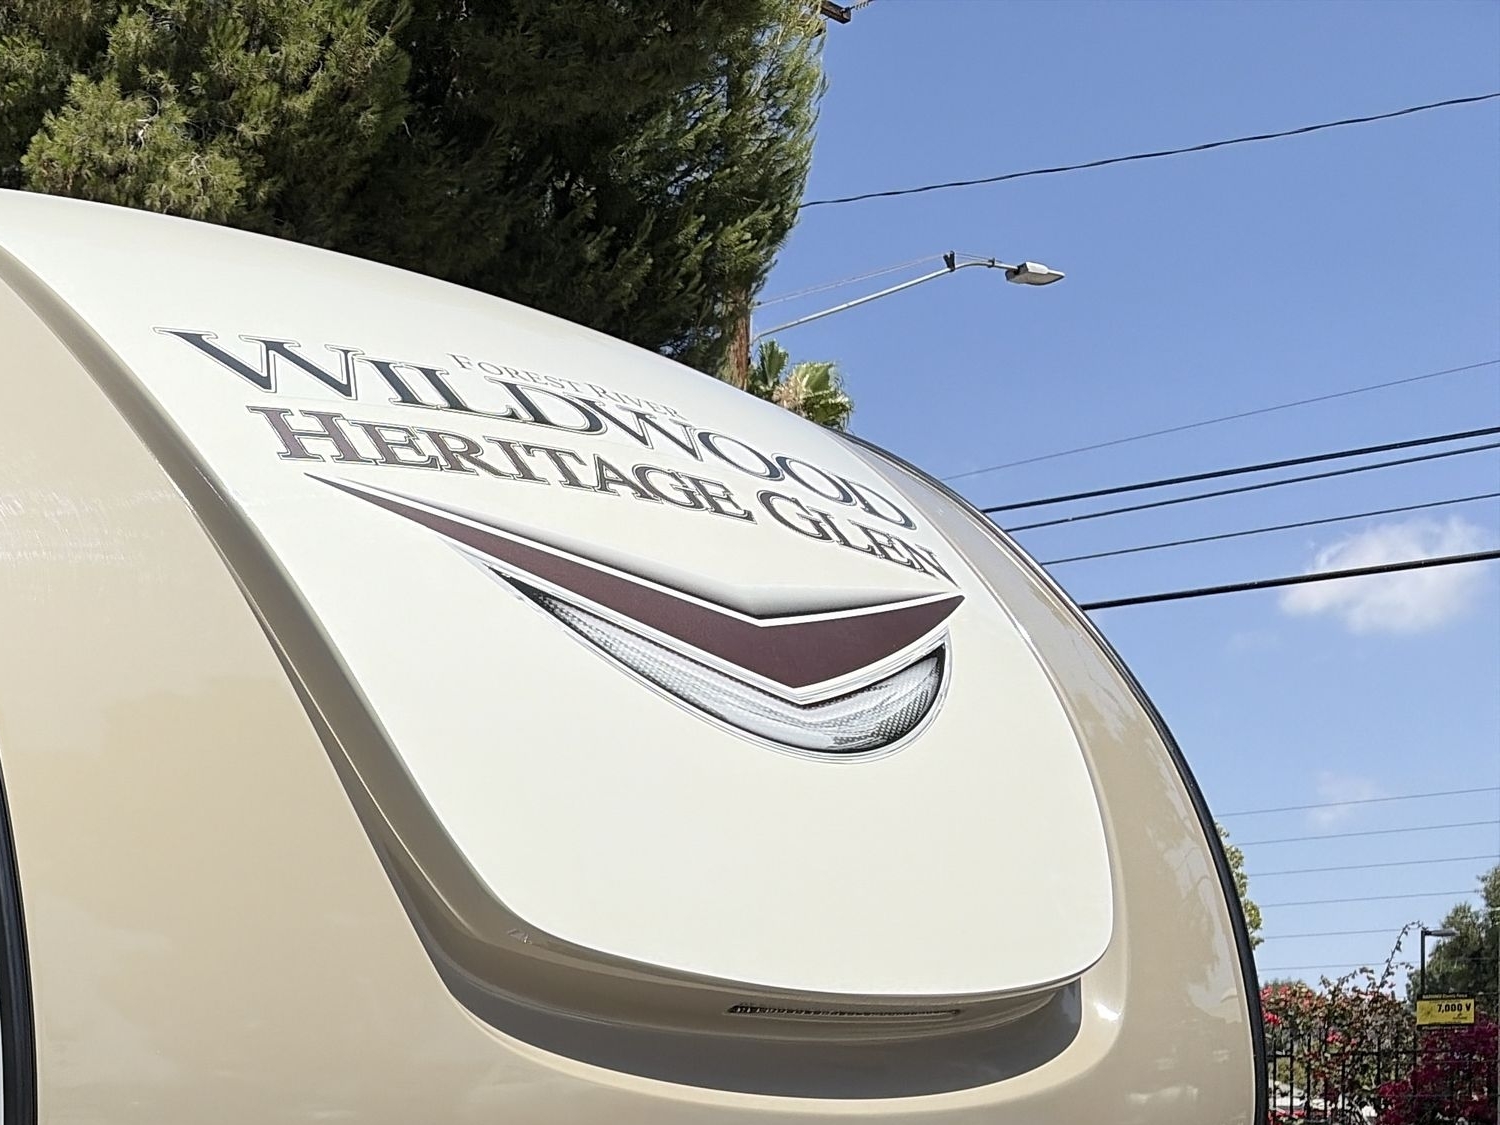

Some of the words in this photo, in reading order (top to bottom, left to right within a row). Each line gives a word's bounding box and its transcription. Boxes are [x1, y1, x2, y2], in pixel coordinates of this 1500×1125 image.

[152, 326, 917, 531] WILDWOOD
[447, 353, 582, 393] FOREST
[585, 383, 688, 421] RIVER
[245, 405, 758, 525] HERITAGE
[756, 489, 961, 588] GLEN
[1437, 1003, 1463, 1014] 7,000
